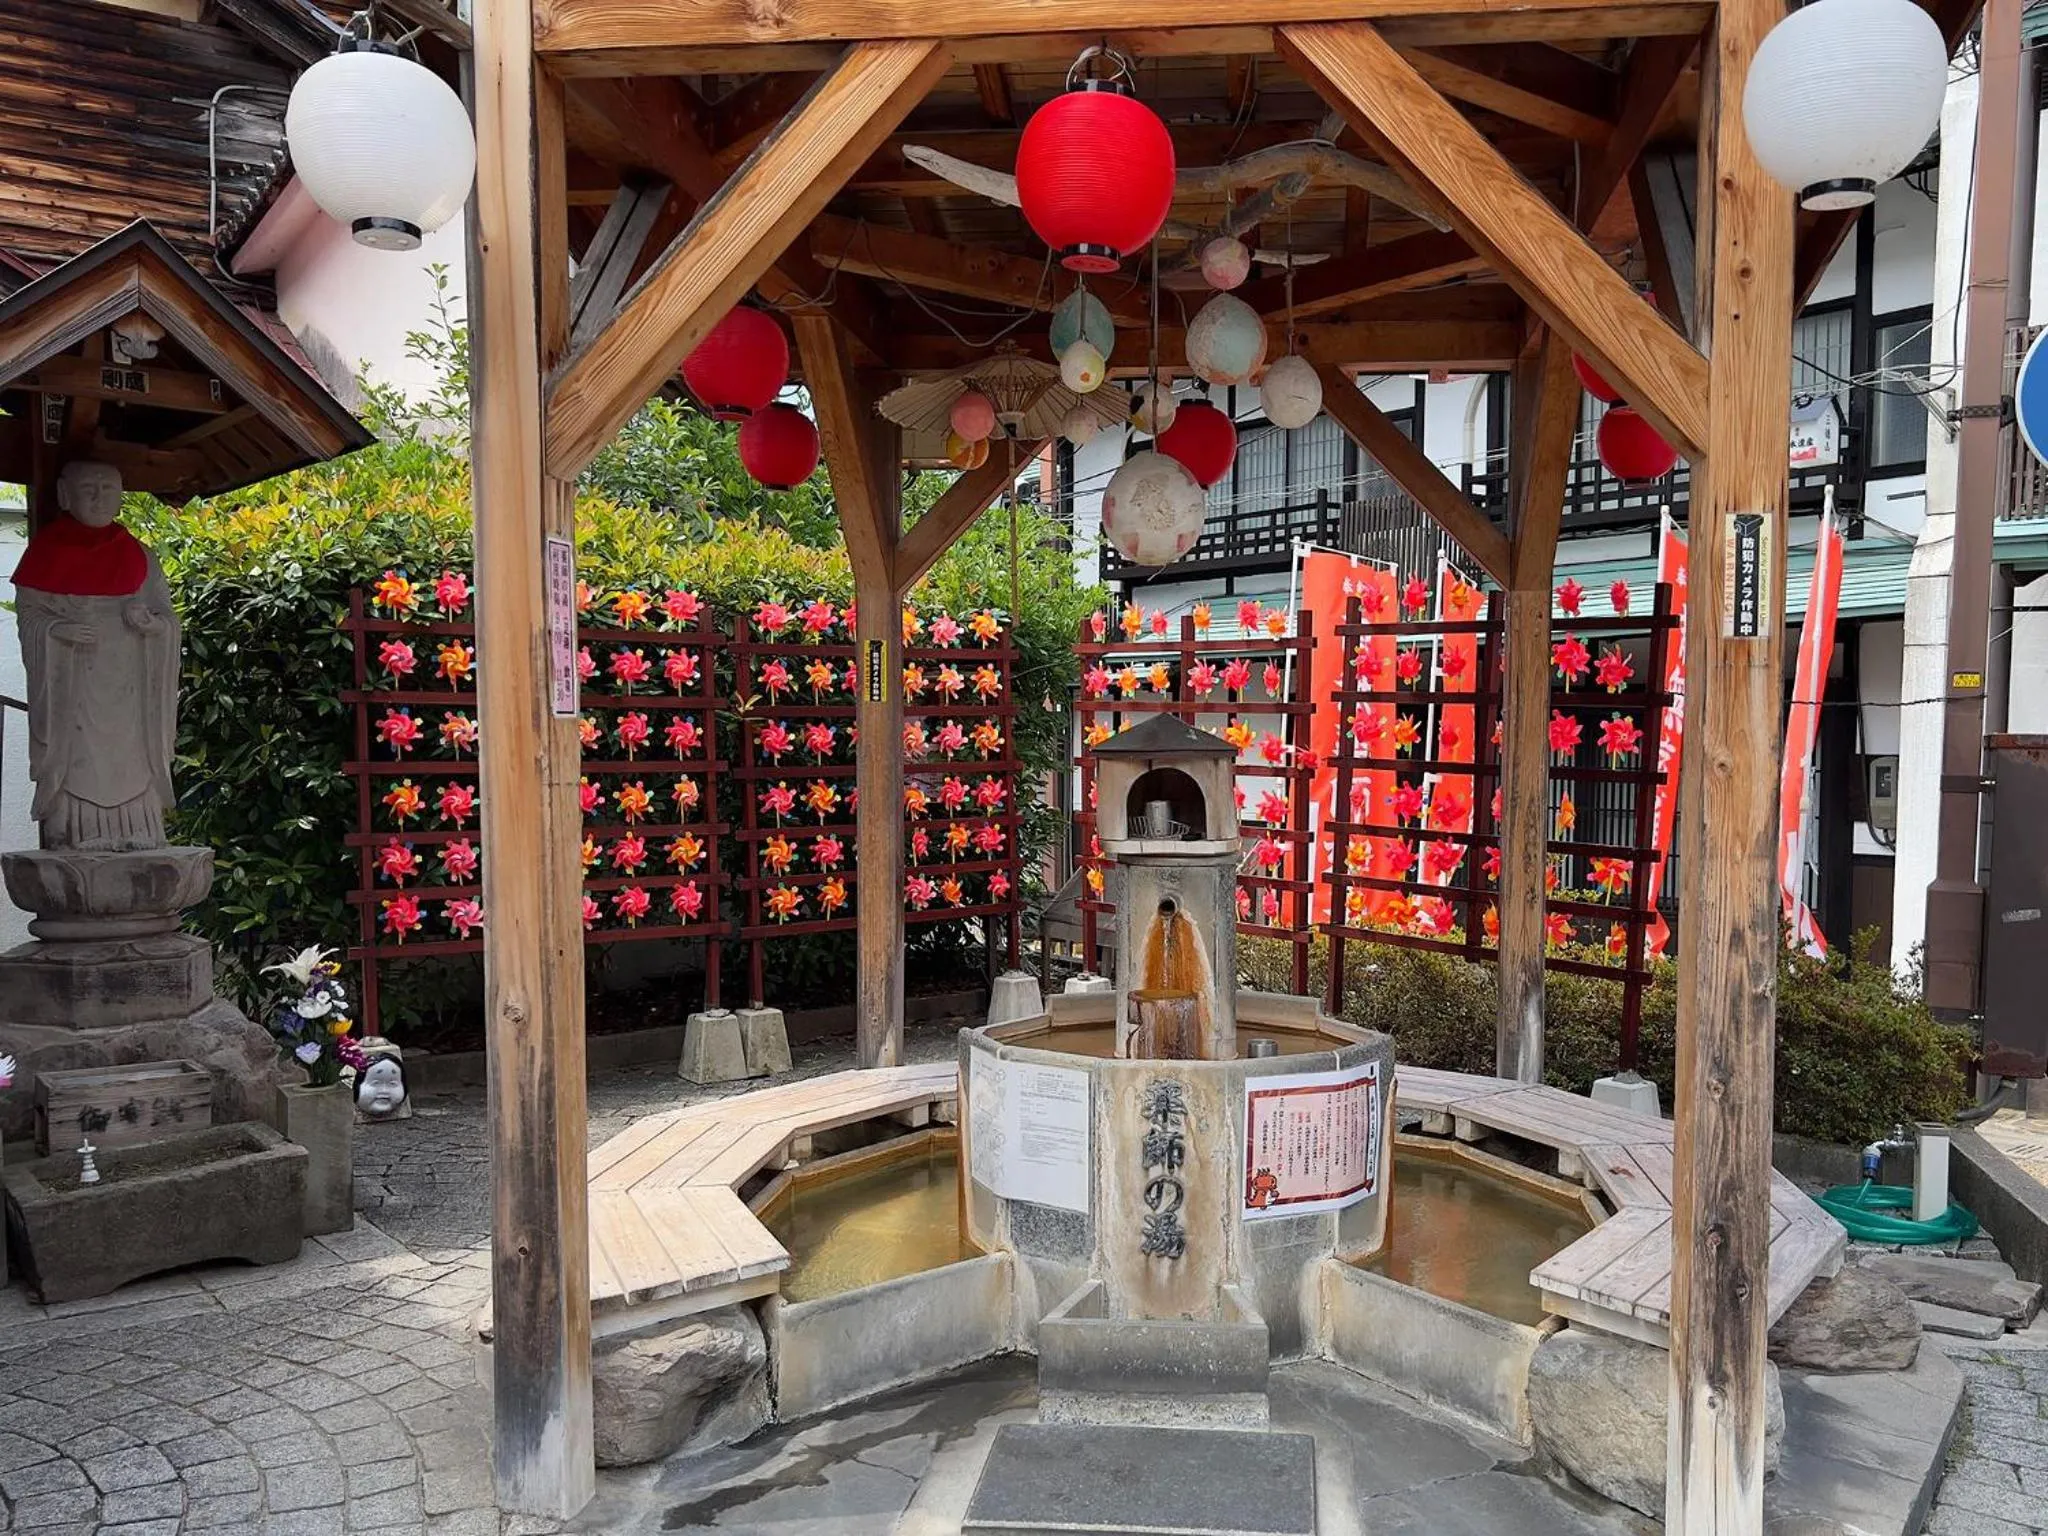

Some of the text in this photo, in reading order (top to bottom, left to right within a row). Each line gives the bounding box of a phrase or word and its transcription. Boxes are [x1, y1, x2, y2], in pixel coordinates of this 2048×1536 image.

[1740, 538, 1754, 635] 防犯カメラ作動中
[1142, 1079, 1188, 1260] 薬師の湯
